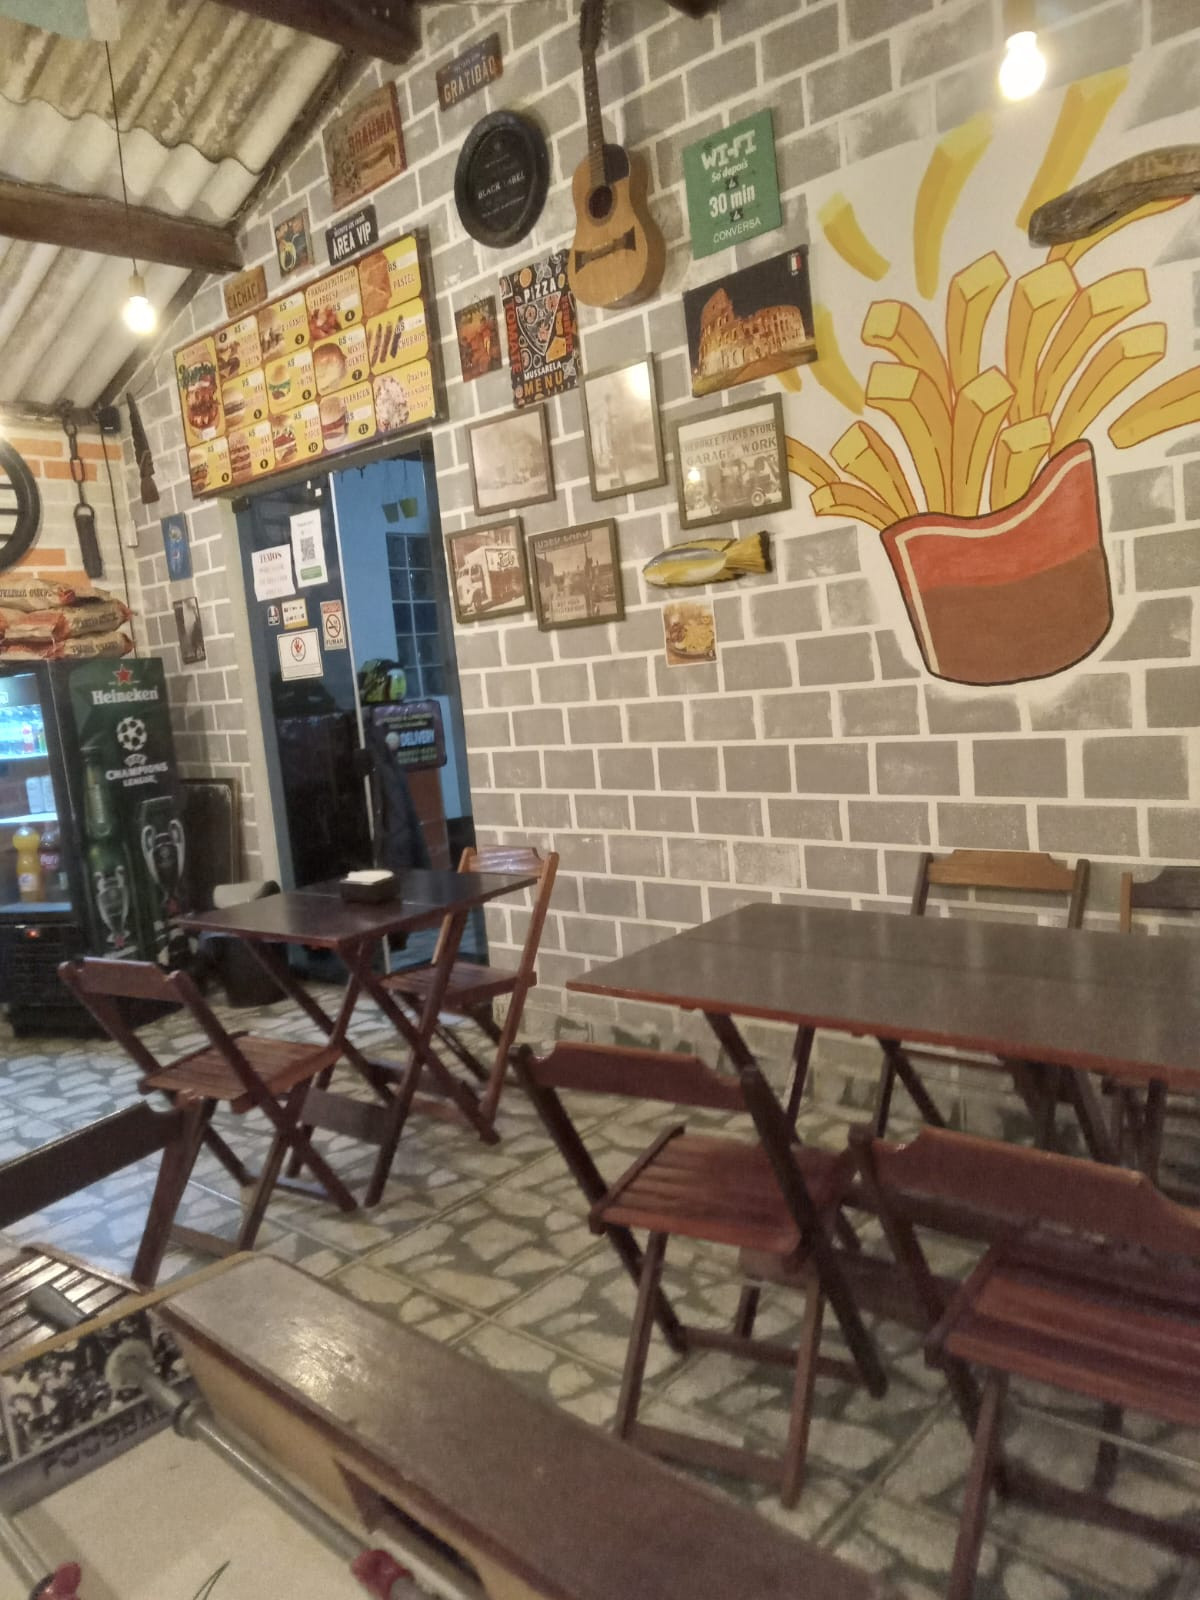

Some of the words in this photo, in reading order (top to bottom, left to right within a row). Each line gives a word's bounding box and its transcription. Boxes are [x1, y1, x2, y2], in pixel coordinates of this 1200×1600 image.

[443, 55, 496, 104] GRATIDÃO
[348, 110, 393, 158] BRAHMA
[722, 158, 748, 177] depois
[477, 181, 501, 200] BLACK
[709, 192, 727, 218] 30
[730, 184, 755, 209] min
[356, 221, 372, 246] VIP
[713, 216, 761, 244] CONVERSA
[523, 276, 557, 303] PIZZA
[504, 300, 523, 375] TOMATE
[524, 361, 562, 380] MUSSARELA
[524, 370, 564, 398] MENU
[749, 422, 776, 436] STORE
[742, 436, 777, 455] WORK
[325, 638, 344, 647] FUMAR
[91, 686, 159, 705] Heineken
[400, 729, 435, 748] DELIVERY
[105, 761, 168, 780] CHAMPIONS
